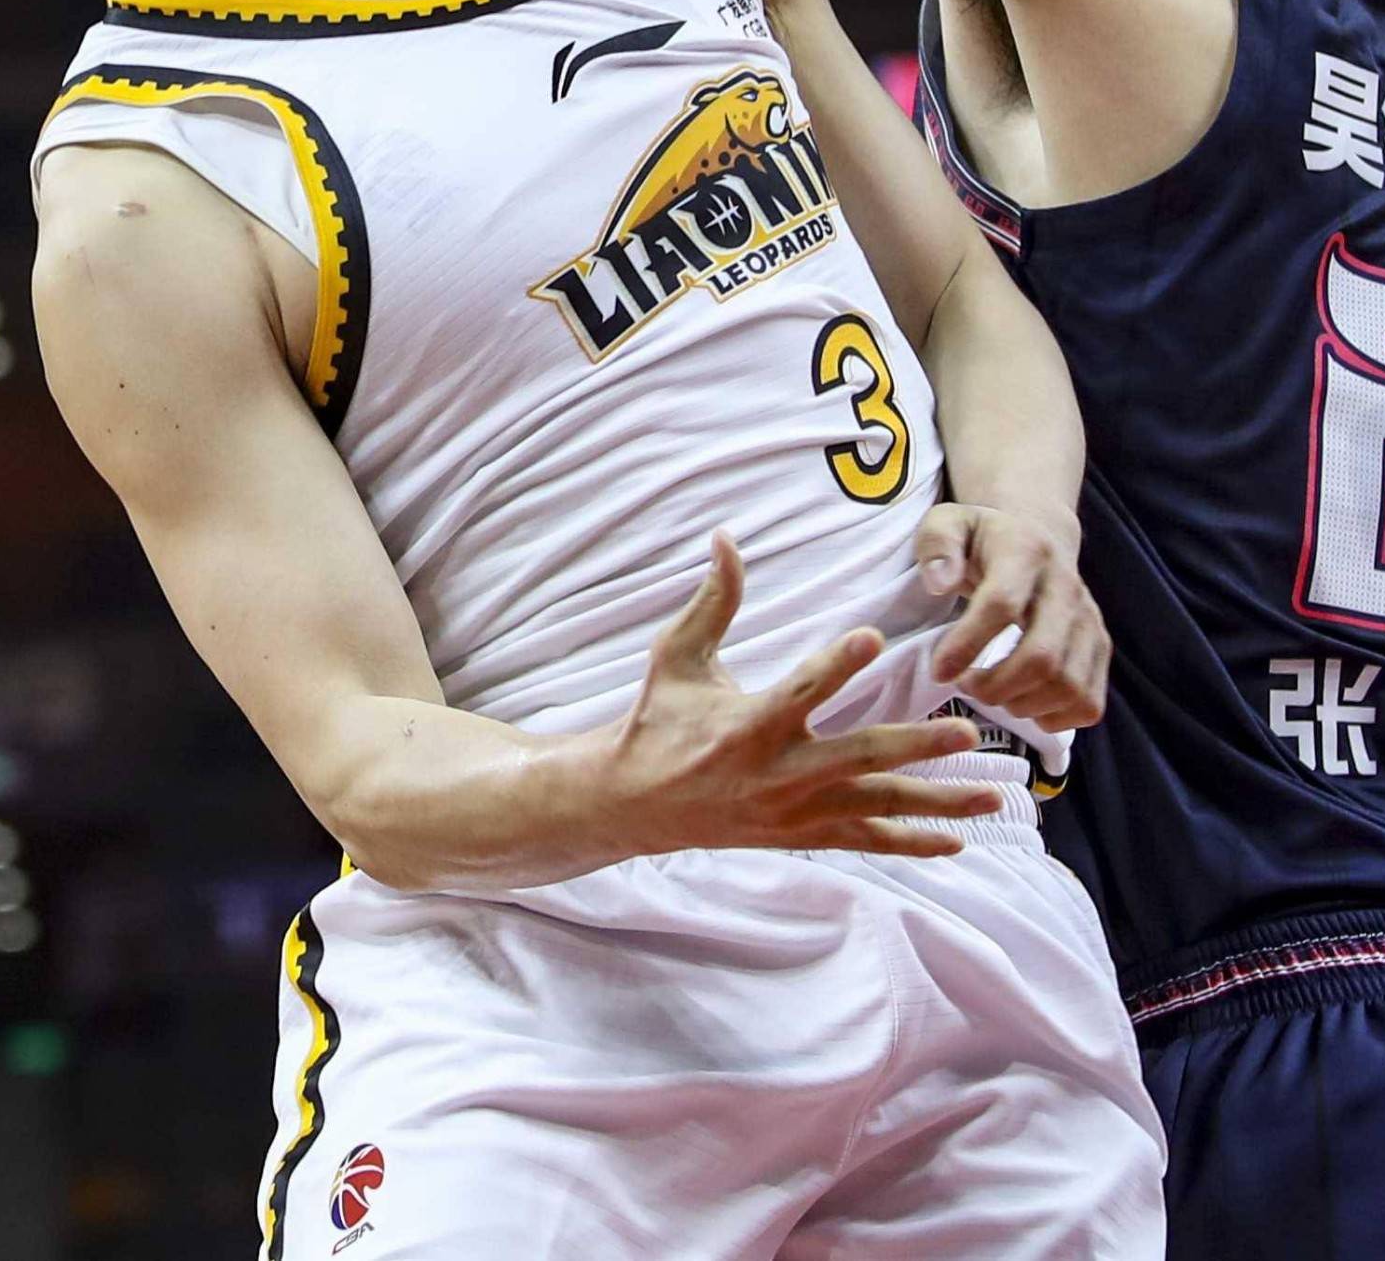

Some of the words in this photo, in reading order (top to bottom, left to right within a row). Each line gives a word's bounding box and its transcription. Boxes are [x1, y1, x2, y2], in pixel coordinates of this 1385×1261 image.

[705, 212, 834, 295] LEOPARDS
[811, 312, 913, 504] 3
[331, 1221, 376, 1257] CBA
